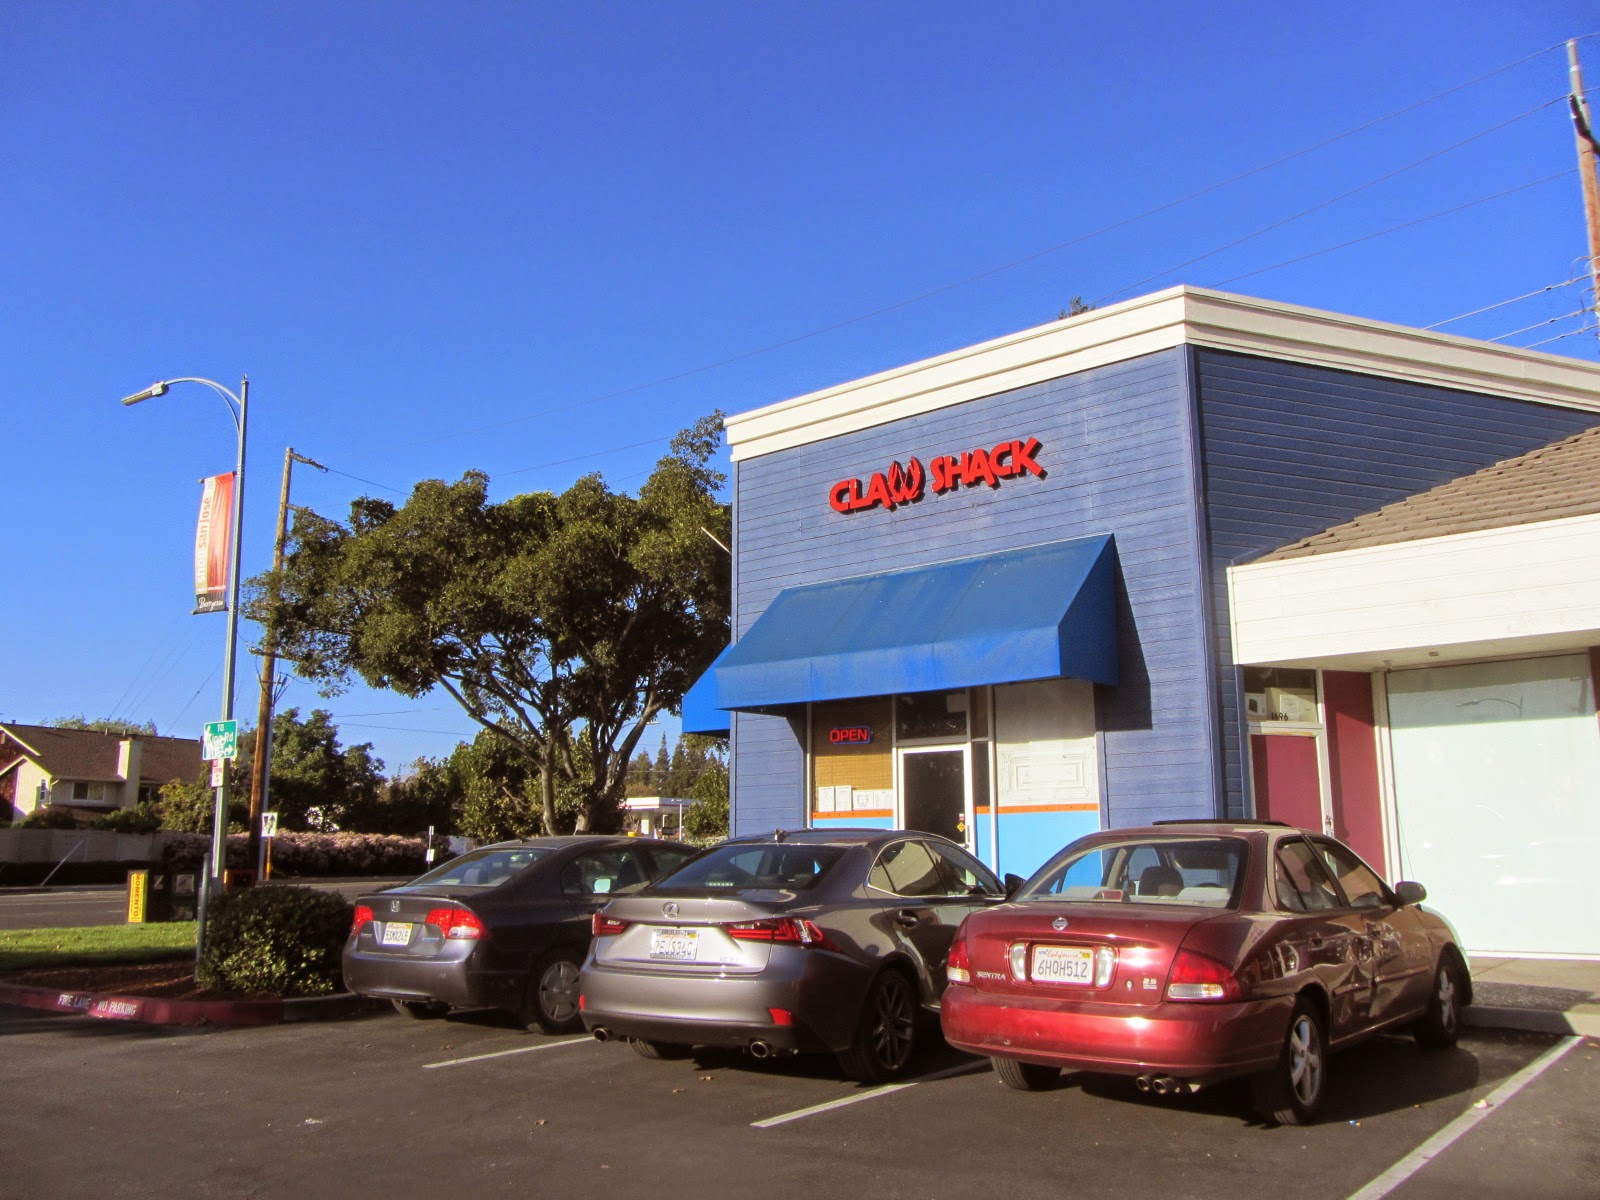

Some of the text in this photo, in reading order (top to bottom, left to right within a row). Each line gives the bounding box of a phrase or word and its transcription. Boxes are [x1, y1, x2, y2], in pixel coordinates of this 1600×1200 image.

[829, 437, 1044, 512] CLAW SHACK
[830, 729, 868, 742] OPEN
[1047, 949, 1078, 959] California
[976, 971, 1006, 980] SENTRA
[58, 994, 73, 1007] FIRE
[97, 1000, 108, 1011] NO
[109, 1001, 137, 1015] PARKING
